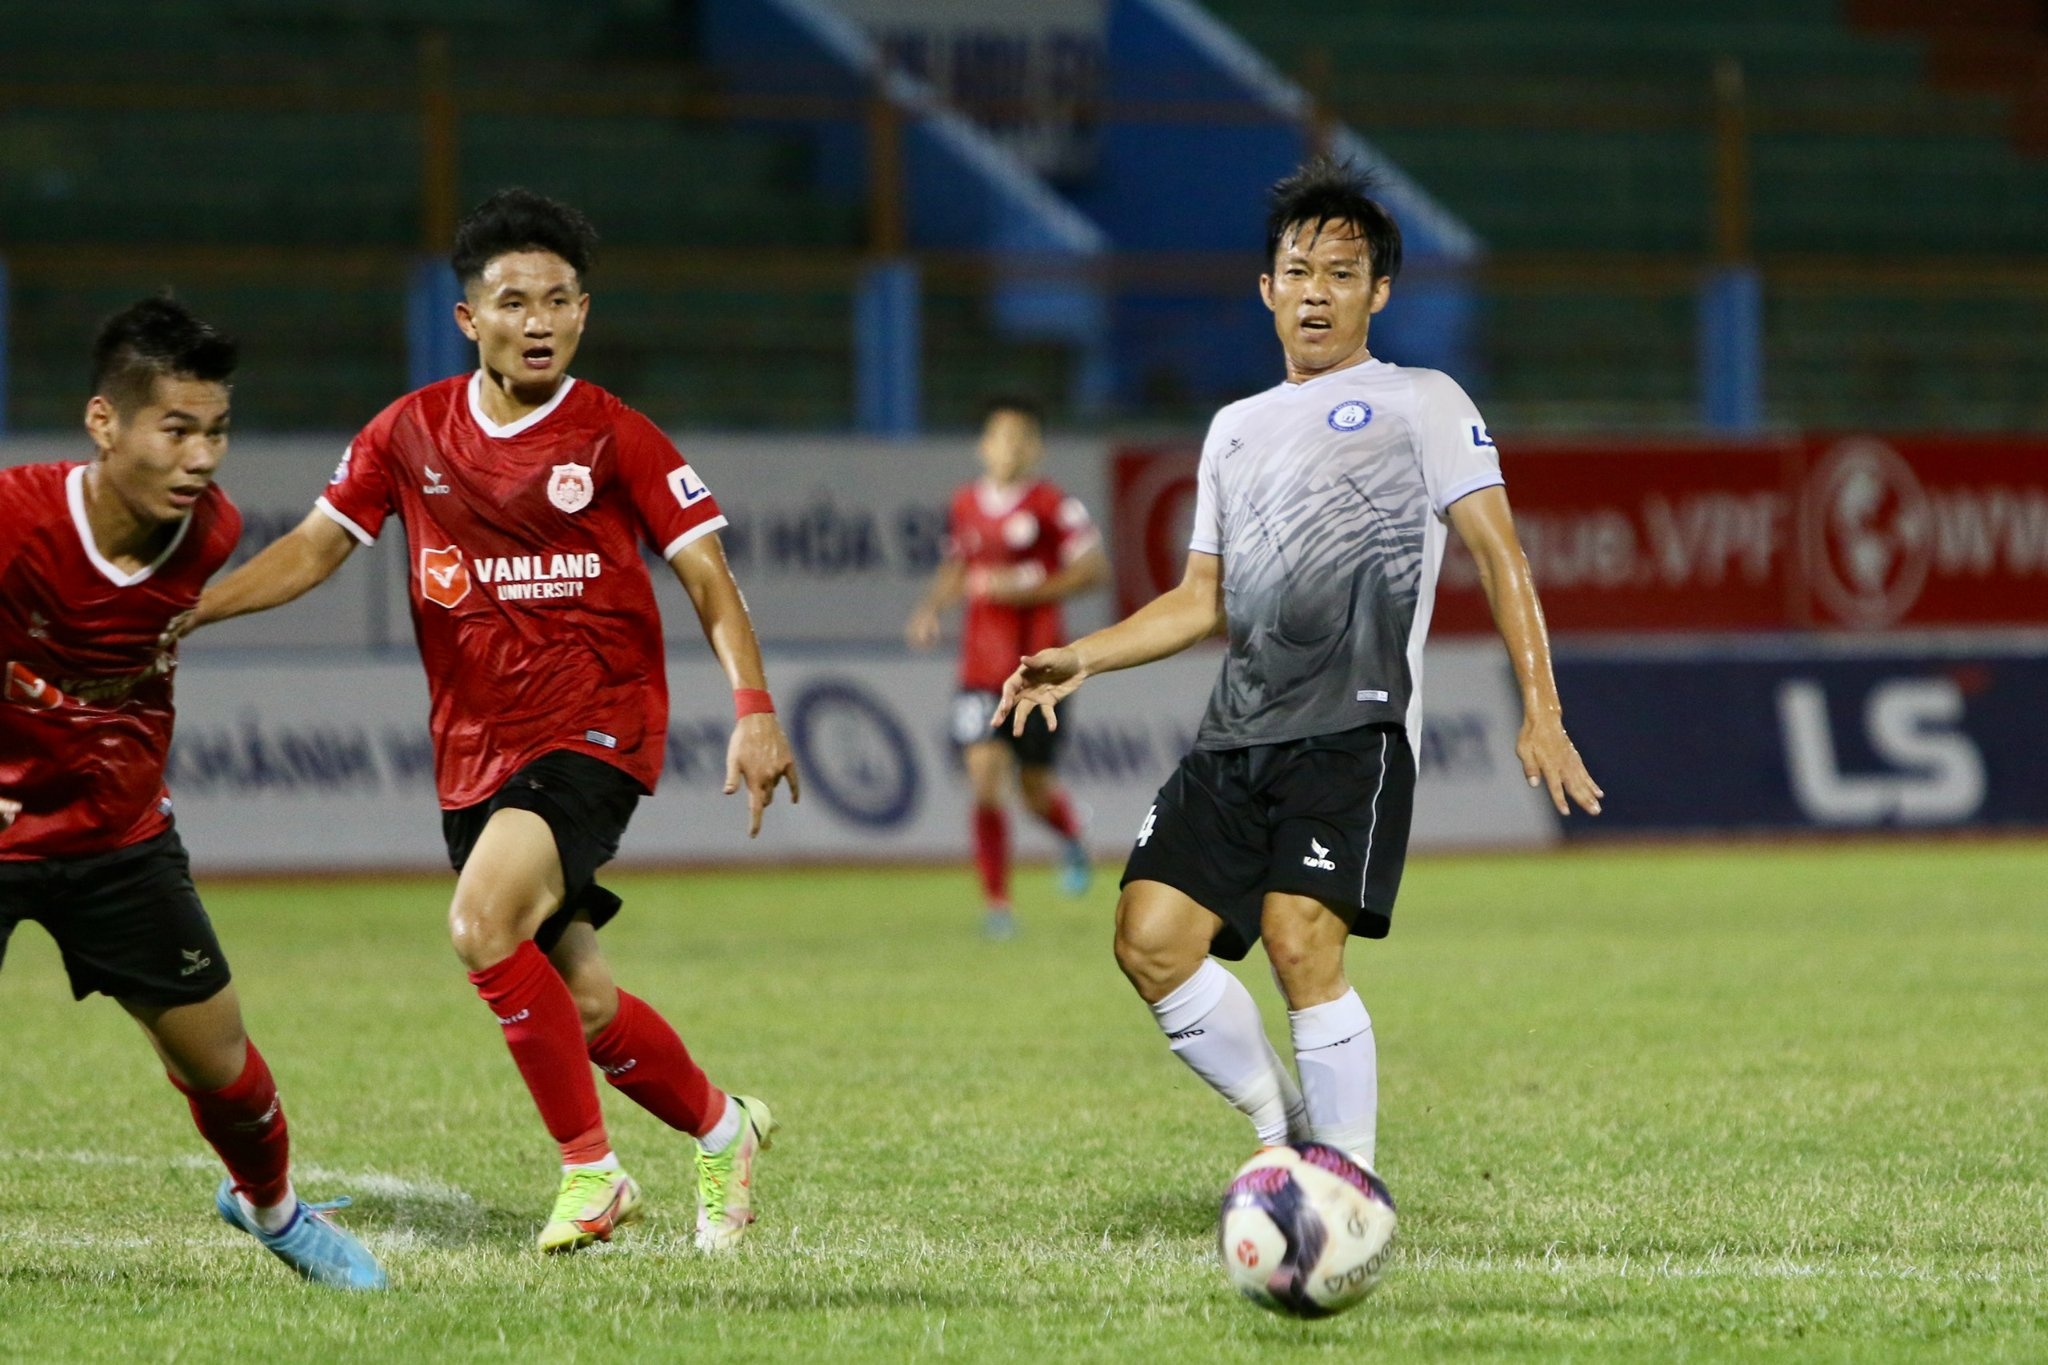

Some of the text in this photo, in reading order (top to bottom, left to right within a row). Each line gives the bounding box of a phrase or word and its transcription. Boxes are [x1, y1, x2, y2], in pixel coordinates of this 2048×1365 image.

[474, 553, 601, 583] VANLANG
[497, 581, 585, 601] UNIVERSITY
[1775, 675, 1990, 828] LS
